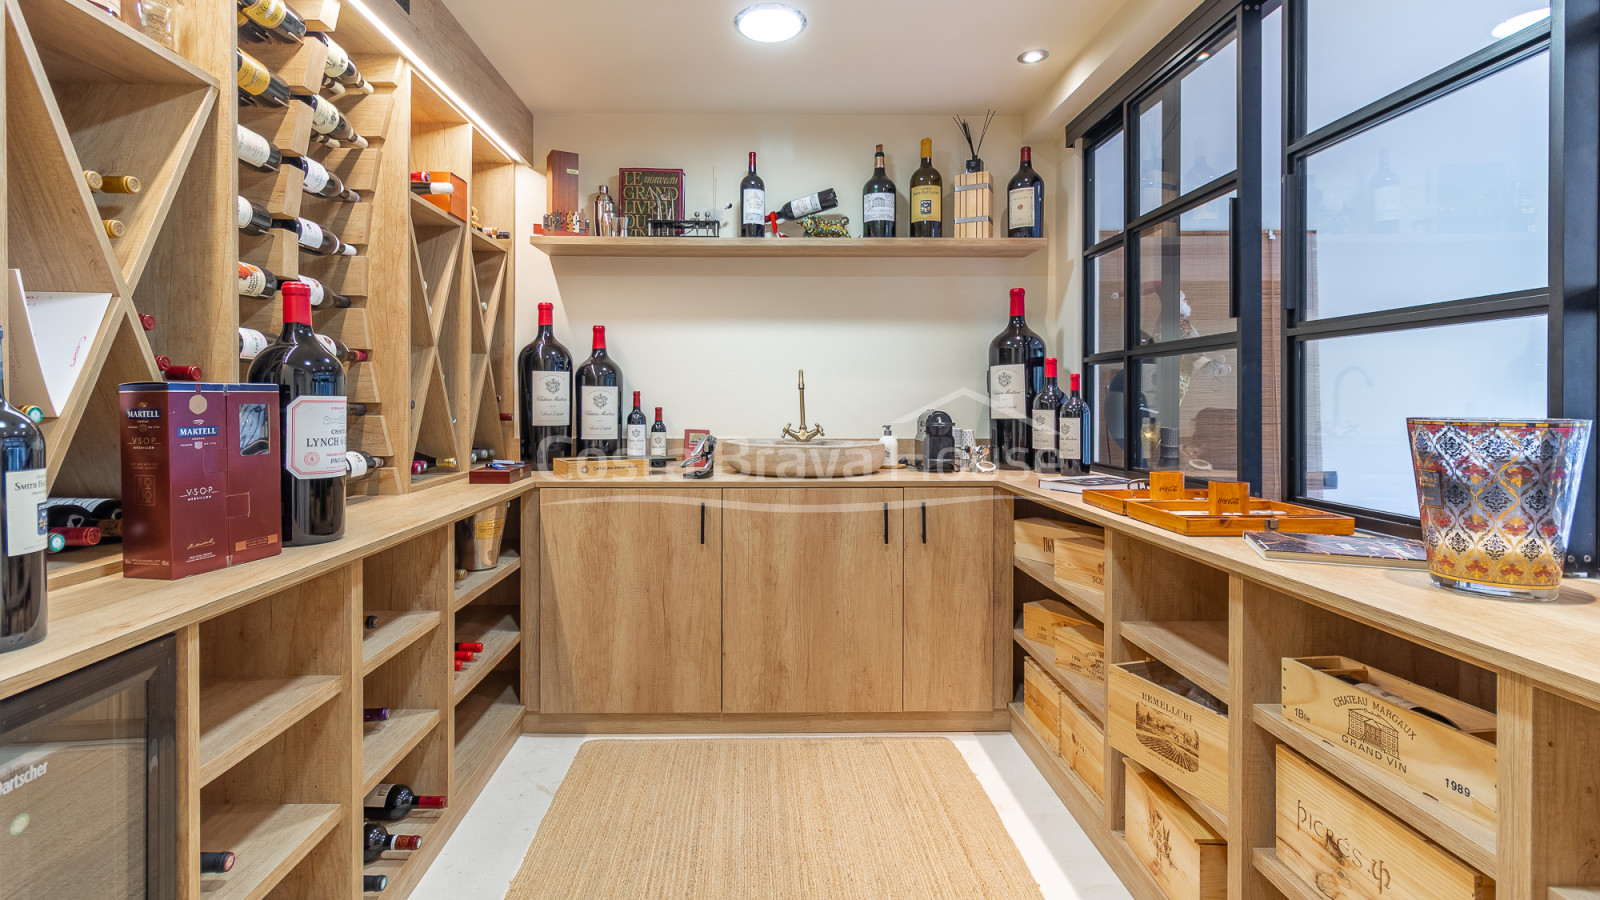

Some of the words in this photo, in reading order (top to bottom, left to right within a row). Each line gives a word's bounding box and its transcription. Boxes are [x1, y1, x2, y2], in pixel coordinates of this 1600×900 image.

[624, 171, 642, 185] LE
[644, 176, 679, 185] nouveau
[623, 186, 679, 200] GRAND
[624, 201, 667, 214] LIVRE
[628, 214, 647, 228] DU
[127, 410, 160, 418] MARTELL
[179, 427, 216, 436] MARTELL
[306, 436, 339, 448] LYNCH
[14, 481, 37, 491] SMITH
[1333, 694, 1368, 708] CHATEAU
[1372, 700, 1417, 741] MARGAUX
[1341, 734, 1384, 761] GRAND
[1386, 757, 1408, 774] VIN
[1444, 777, 1472, 798] 1989
